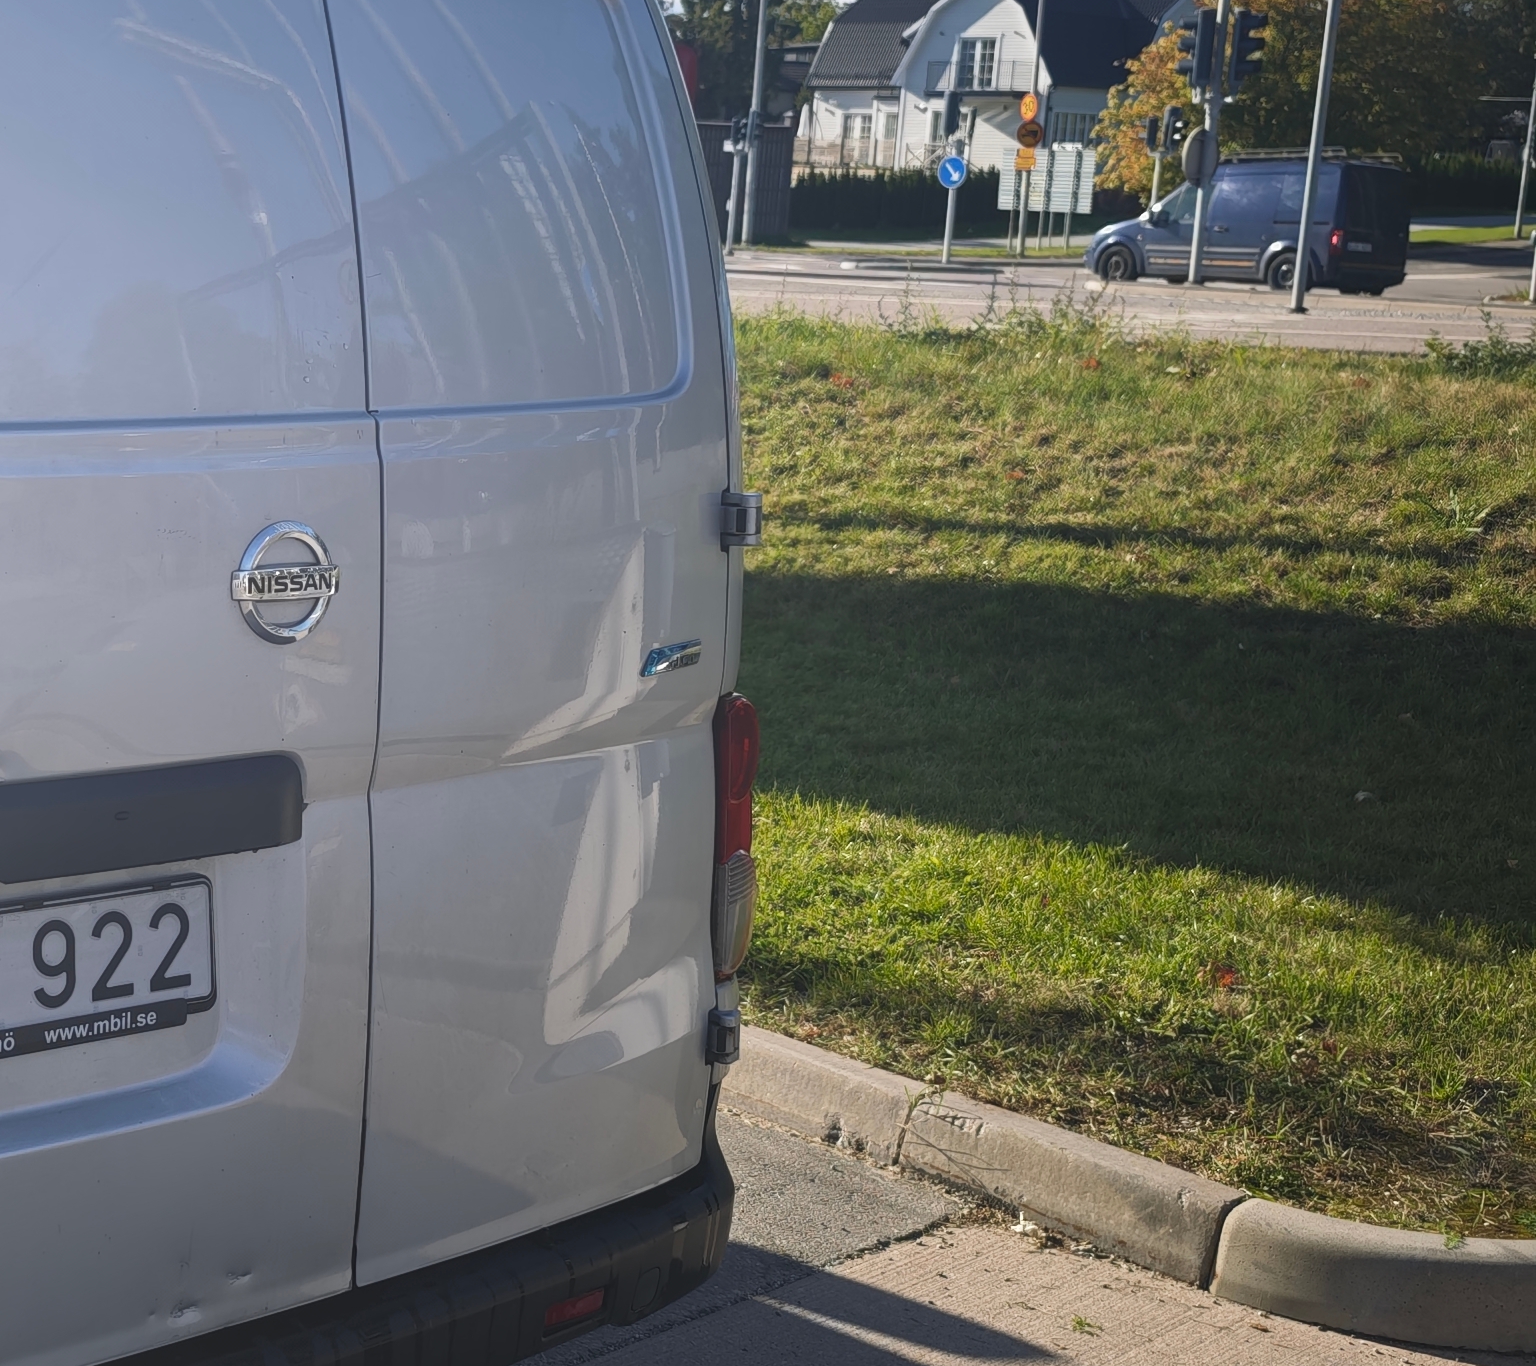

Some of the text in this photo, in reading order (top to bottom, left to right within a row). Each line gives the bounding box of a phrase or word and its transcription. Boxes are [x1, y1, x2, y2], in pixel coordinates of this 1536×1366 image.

[1022, 100, 1035, 116] 30
[247, 572, 332, 595] NISSAN
[32, 902, 192, 1009] 922
[44, 1011, 157, 1045] www.mbil.se
